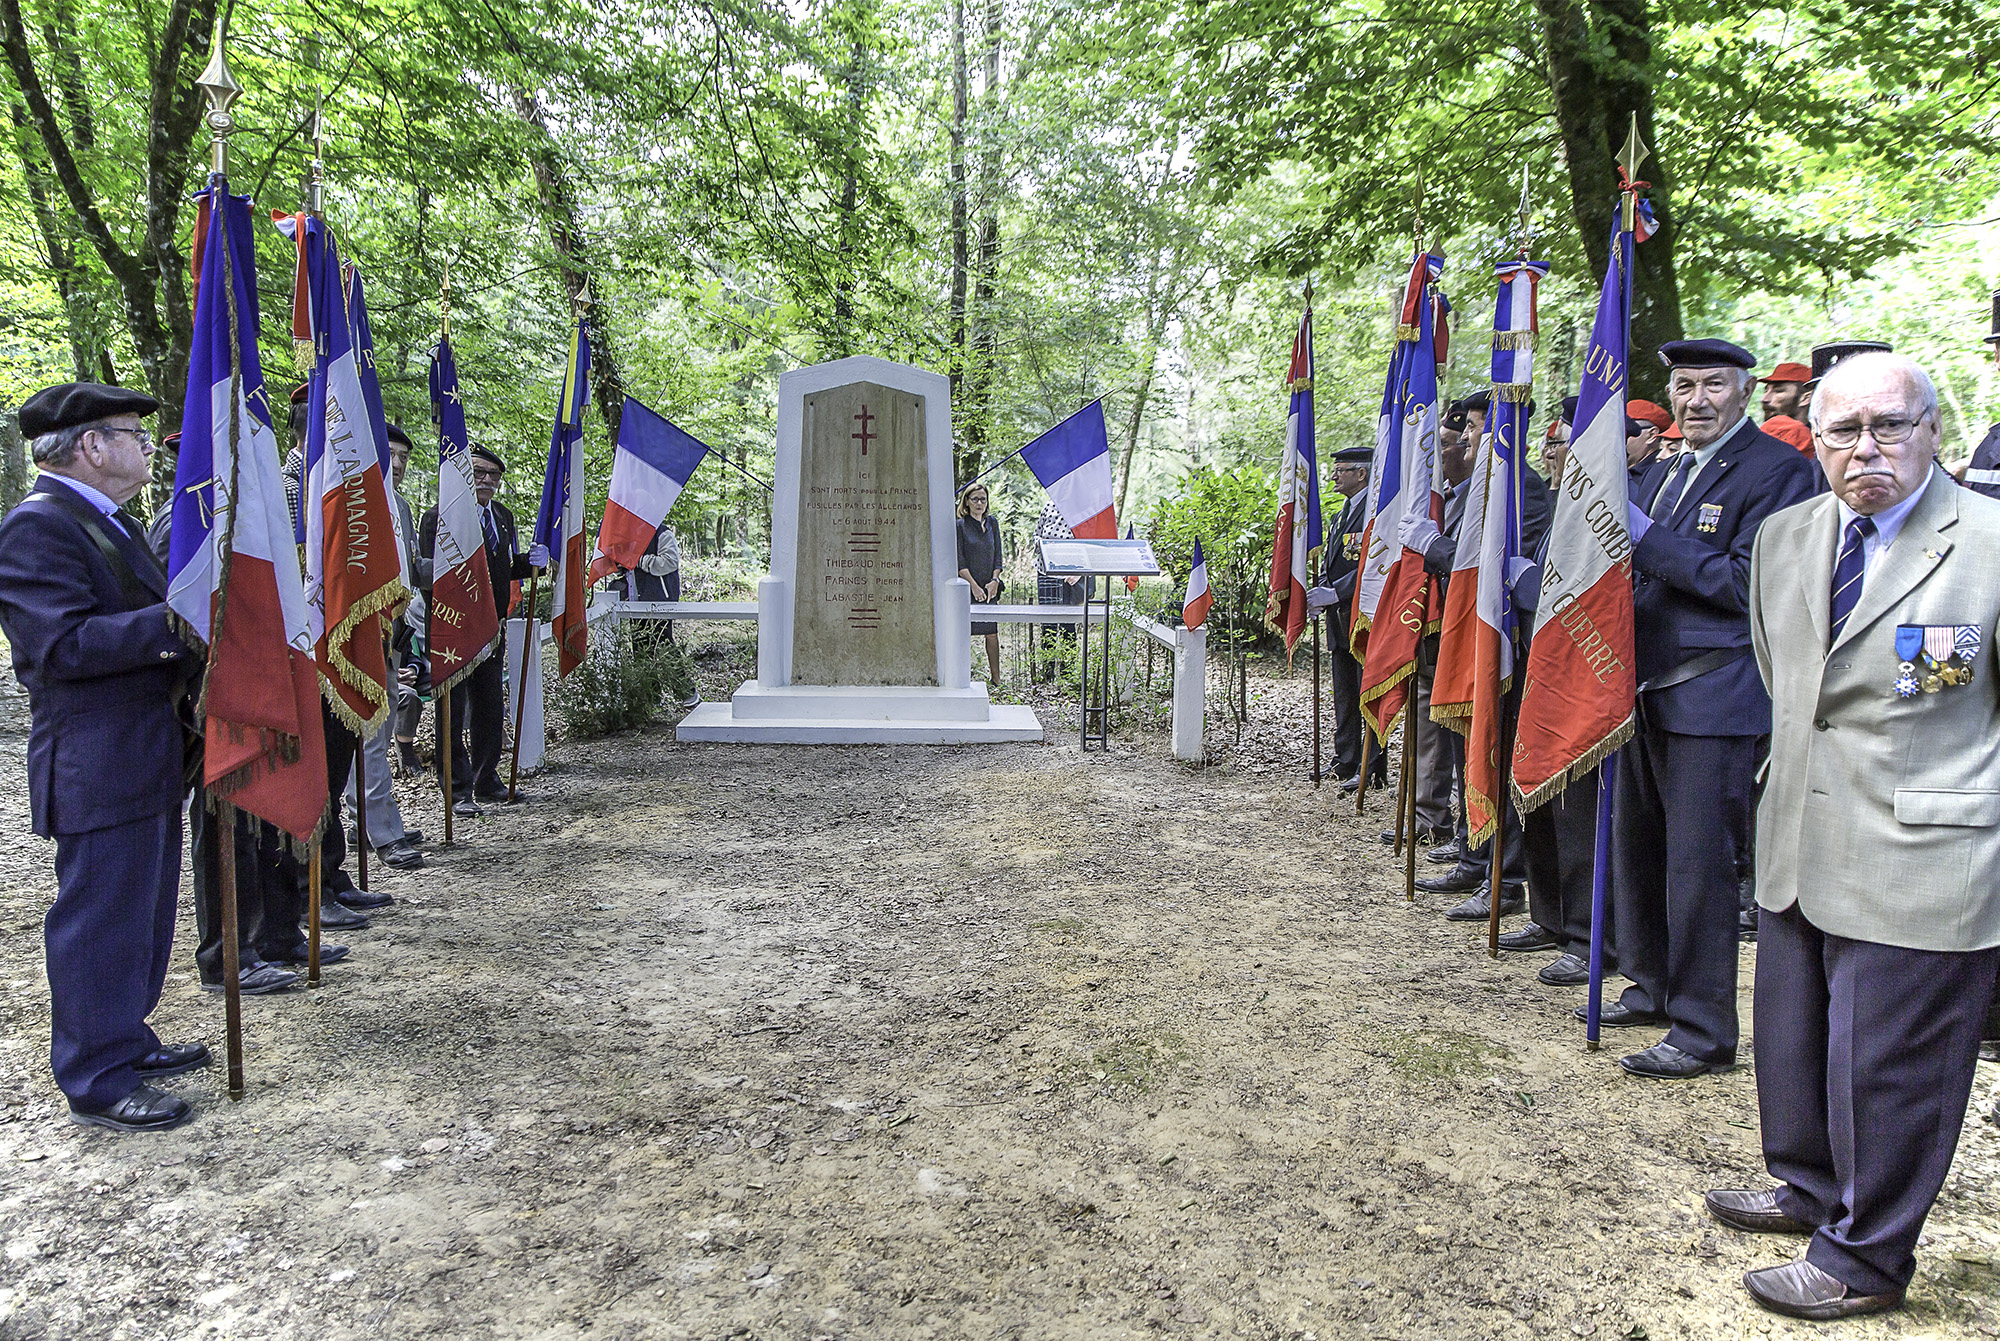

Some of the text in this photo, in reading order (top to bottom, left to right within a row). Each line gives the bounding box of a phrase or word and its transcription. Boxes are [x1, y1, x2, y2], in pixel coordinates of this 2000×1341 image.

[1586, 344, 1625, 401] UNI
[810, 486, 830, 494] SONT
[889, 487, 918, 495] FRANCE
[329, 430, 370, 576] L'ARMAGNAC
[878, 503, 922, 511] ALLEMANDS
[1563, 448, 1634, 581] ENS COMBA
[844, 517, 852, 526] 6
[874, 517, 897, 526] 1944
[825, 558, 904, 569] THIEBAUD HENRI
[824, 575, 904, 586] FARINES PIERRE
[825, 591, 904, 603] LABASTIE JEAN
[1551, 592, 1626, 685] GUERRE
